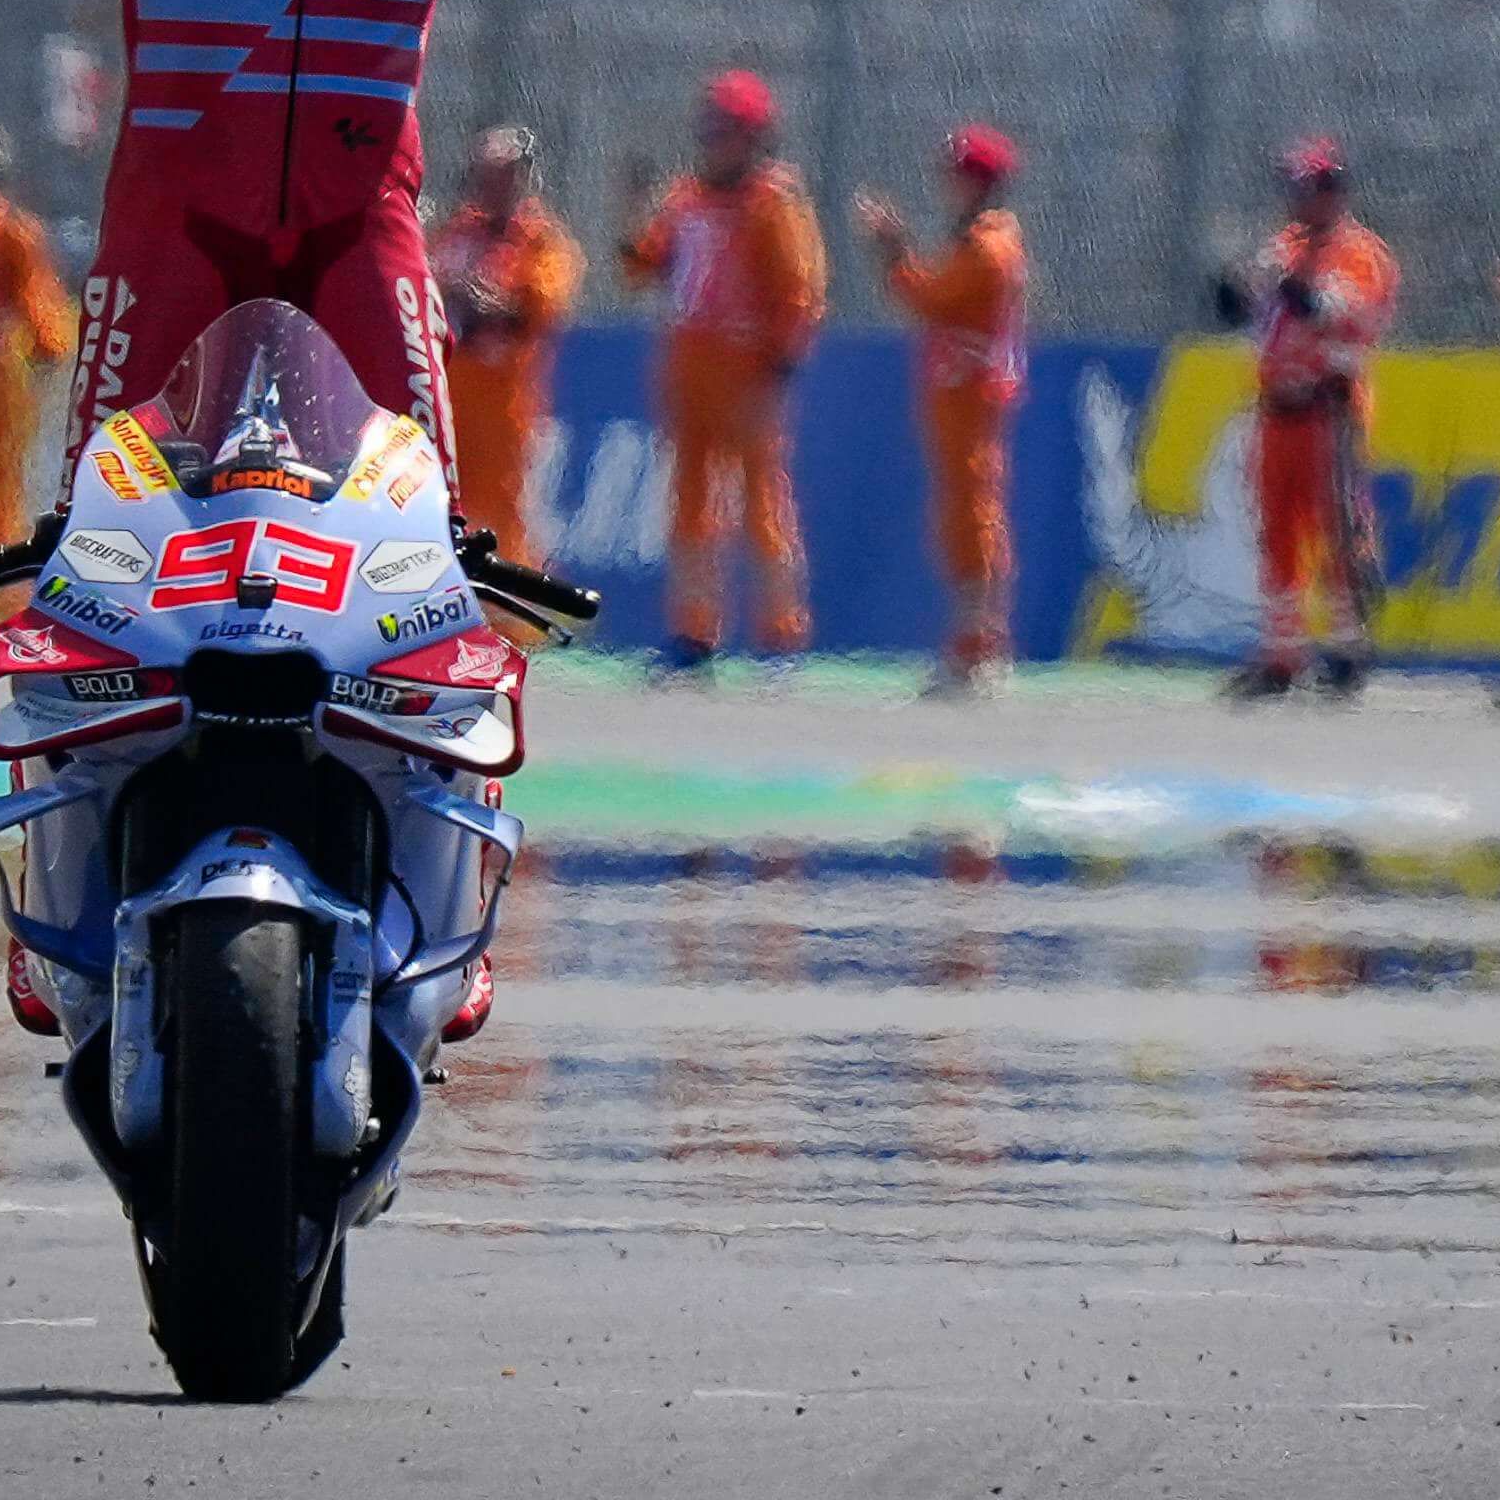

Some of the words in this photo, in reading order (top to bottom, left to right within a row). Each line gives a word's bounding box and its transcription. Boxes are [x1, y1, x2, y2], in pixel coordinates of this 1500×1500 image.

[211, 468, 313, 498] Kapriol
[69, 534, 146, 574] BIGCRAFTERS
[150, 520, 357, 612] 93
[37, 576, 134, 636] Unibat
[376, 592, 469, 644] Unibat
[71, 673, 134, 694] BOLD
[332, 673, 400, 706] BOLD
